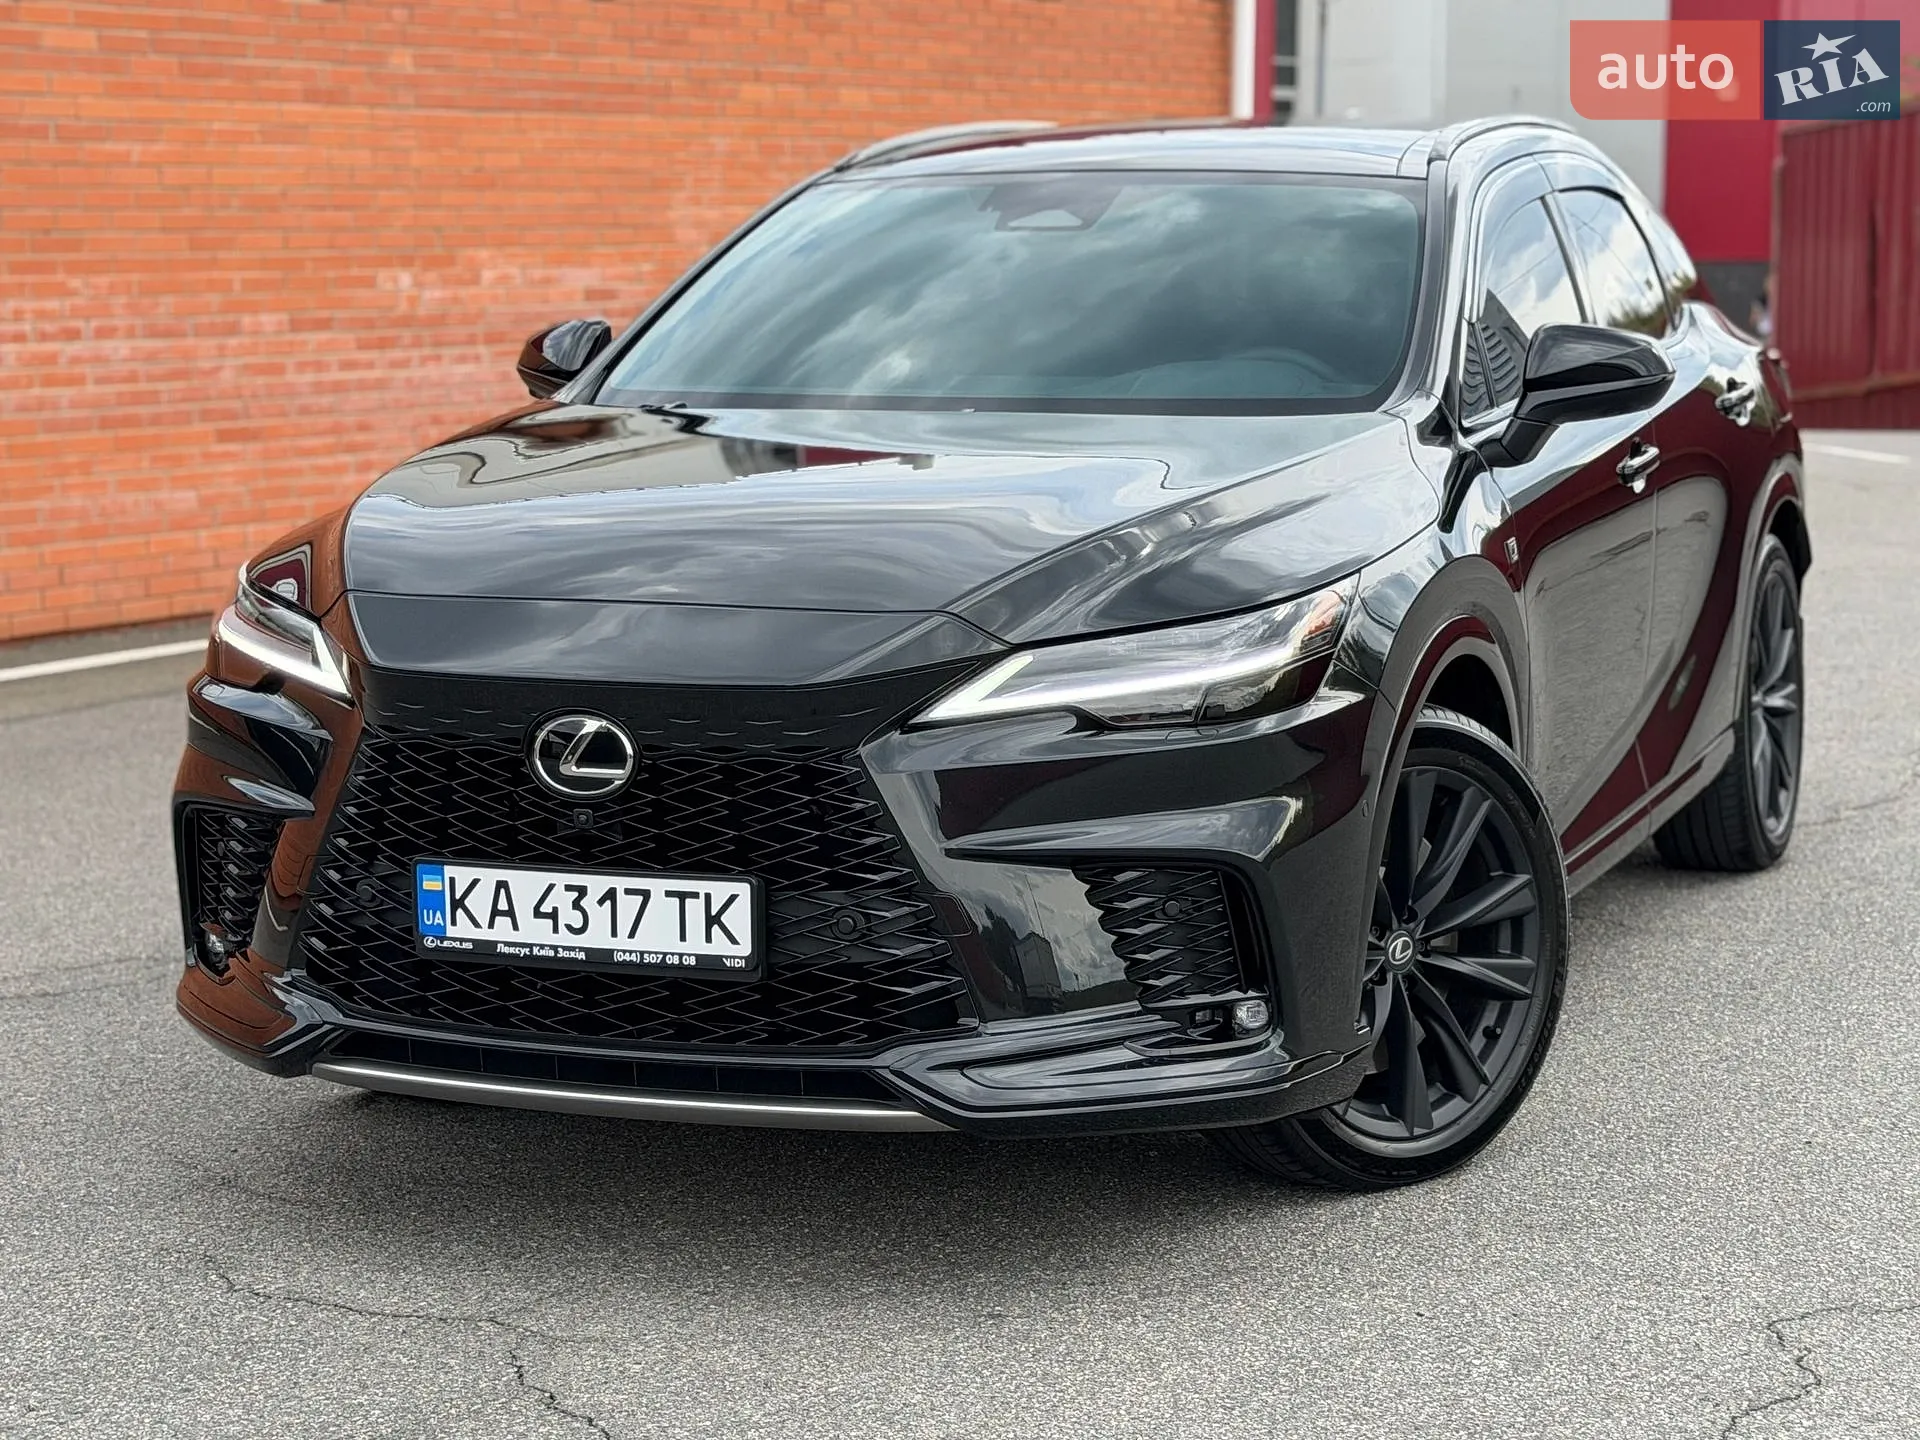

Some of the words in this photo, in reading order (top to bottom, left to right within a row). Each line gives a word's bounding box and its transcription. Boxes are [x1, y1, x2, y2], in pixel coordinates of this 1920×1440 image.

[423, 909, 444, 926] UA
[448, 876, 520, 931] KA
[533, 883, 651, 939] 4317
[664, 889, 741, 946] TK
[437, 940, 473, 949] LEXUS
[496, 943, 530, 957] Лексус
[533, 947, 555, 957] Київ
[557, 947, 586, 960] Захід
[613, 951, 640, 963] (044)
[643, 953, 663, 963] 507
[665, 954, 679, 965] 08
[682, 955, 696, 966] 08
[722, 958, 745, 968] VIDI
